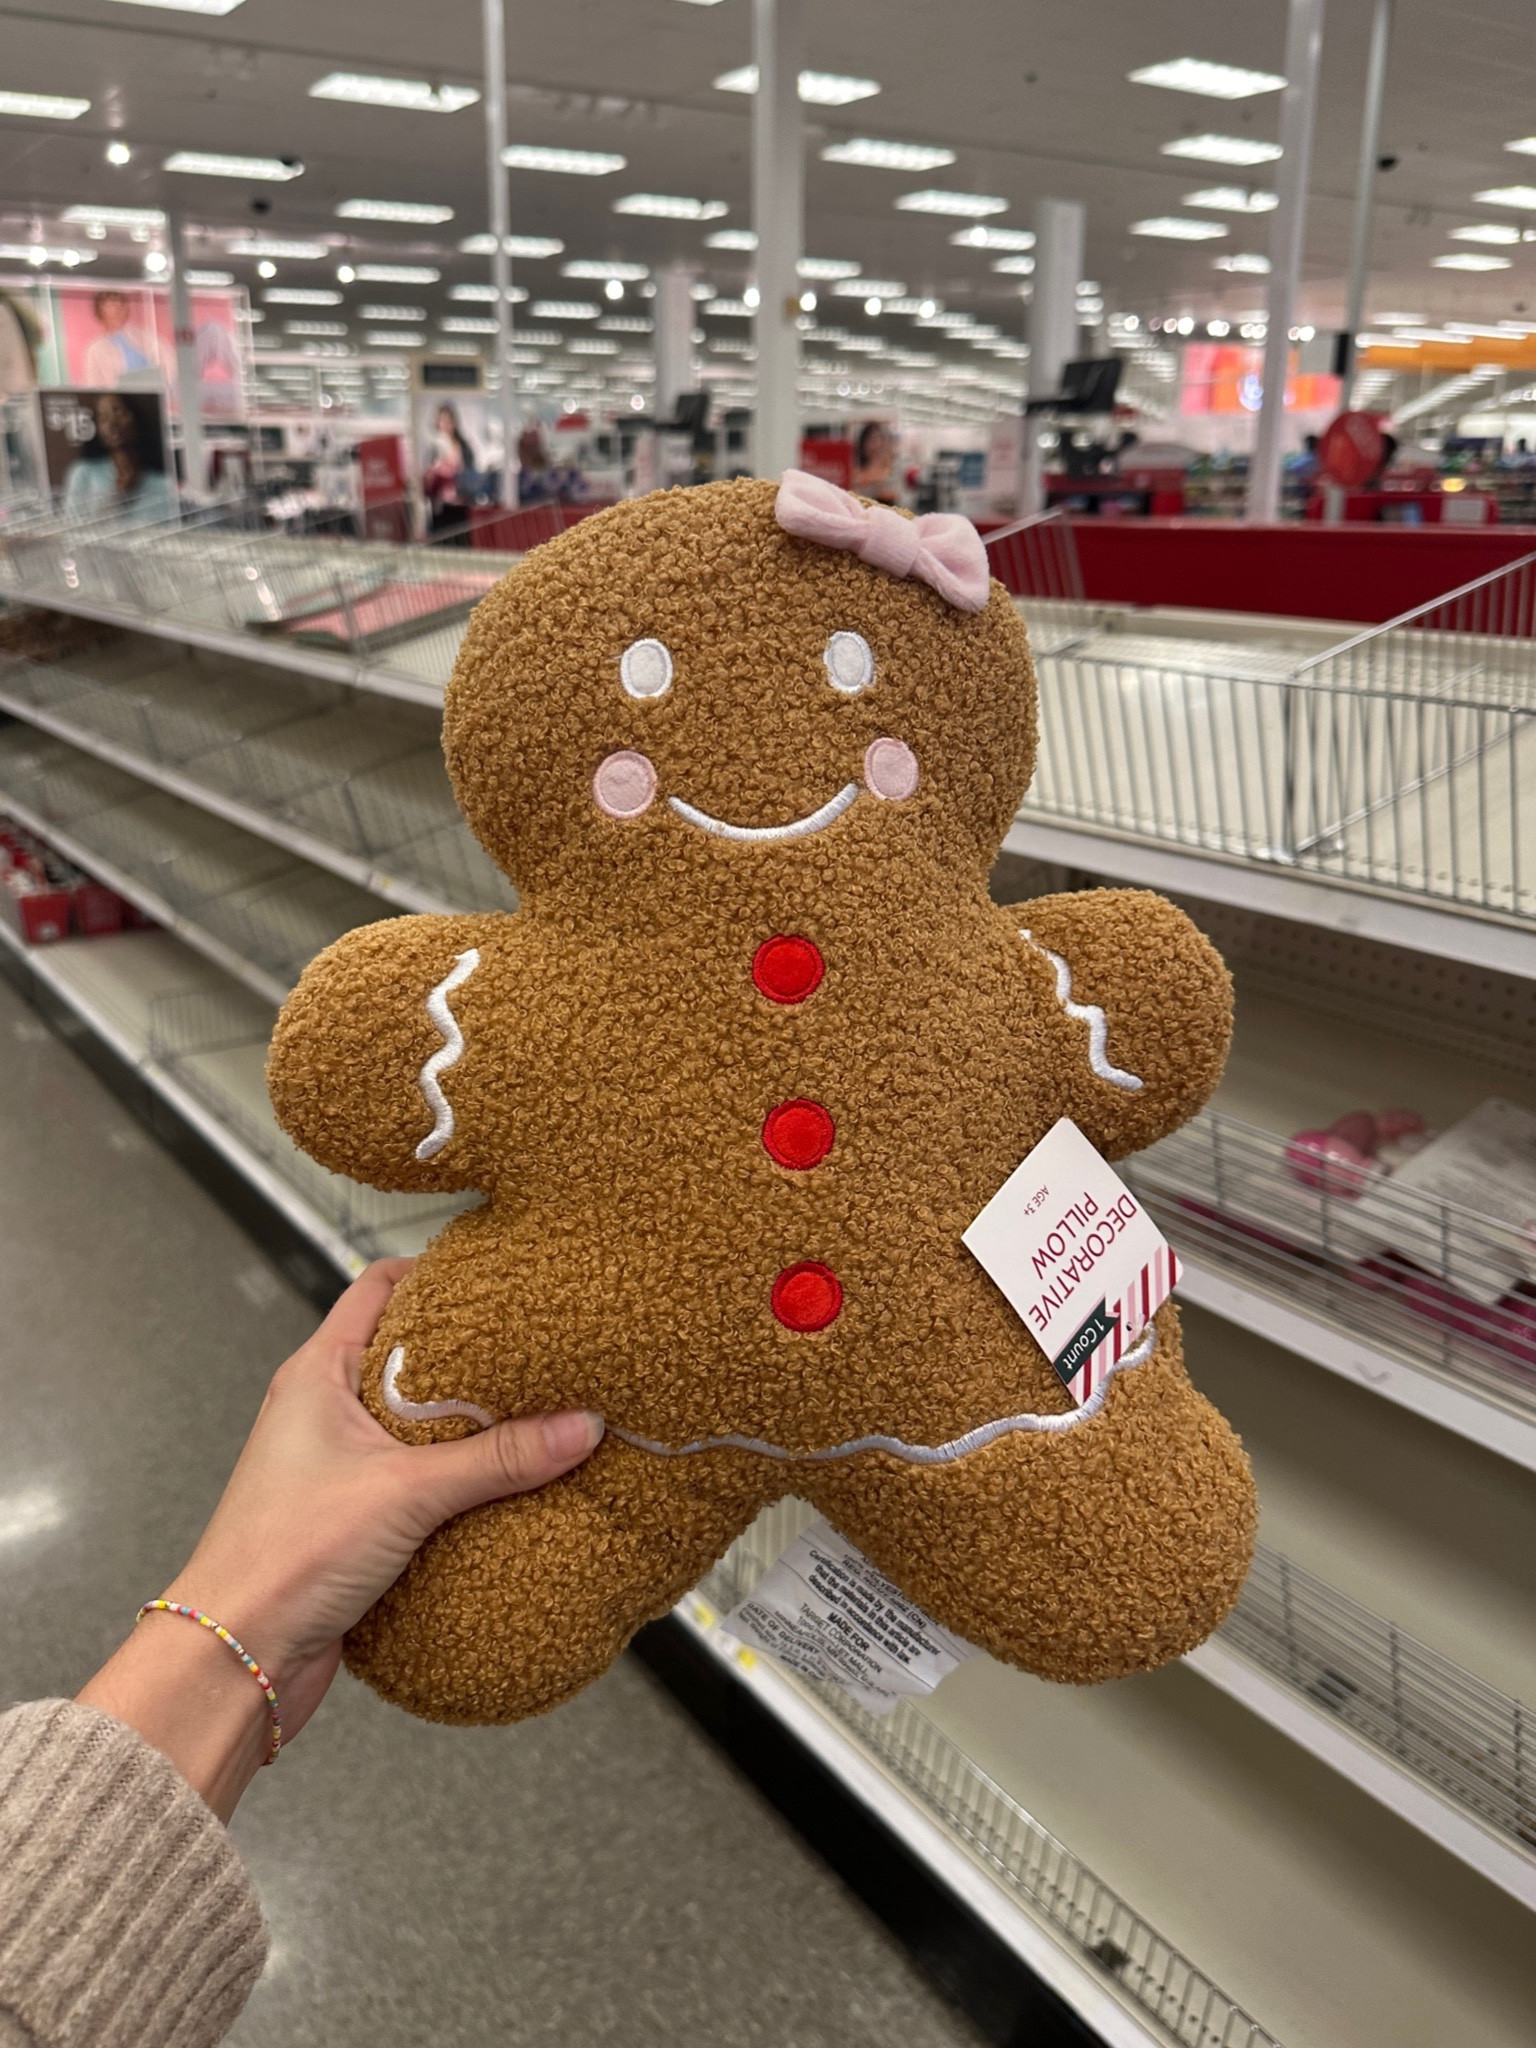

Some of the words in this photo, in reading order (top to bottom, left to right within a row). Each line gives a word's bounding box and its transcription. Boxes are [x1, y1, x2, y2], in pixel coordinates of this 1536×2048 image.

[1022, 1202, 1035, 1216] 3+
[1031, 1184, 1049, 1207] AGE
[1027, 1193, 1138, 1331] DECORATIVE
[1030, 1191, 1099, 1279] PILLOW
[1061, 1325, 1097, 1369] Count
[1093, 1318, 1105, 1330] 1
[746, 1601, 769, 1621] DATE
[766, 1619, 781, 1631] OF
[778, 1630, 820, 1653] DELIVERY
[799, 1602, 831, 1631] TARGET
[828, 1627, 883, 1674] CORPORATION
[808, 1574, 842, 1604] described
[846, 1606, 884, 1642] accordance
[882, 1638, 899, 1654] with
[826, 1575, 839, 1589] the
[838, 1584, 869, 1613] materials
[874, 1615, 889, 1631] this
[887, 1627, 909, 1648] article
[826, 1611, 853, 1636] MADE
[849, 1632, 870, 1651] FOR
[855, 1584, 875, 1603] made
[873, 1598, 885, 1611] by
[884, 1607, 897, 1622] the
[895, 1619, 940, 1655] manufacturer
